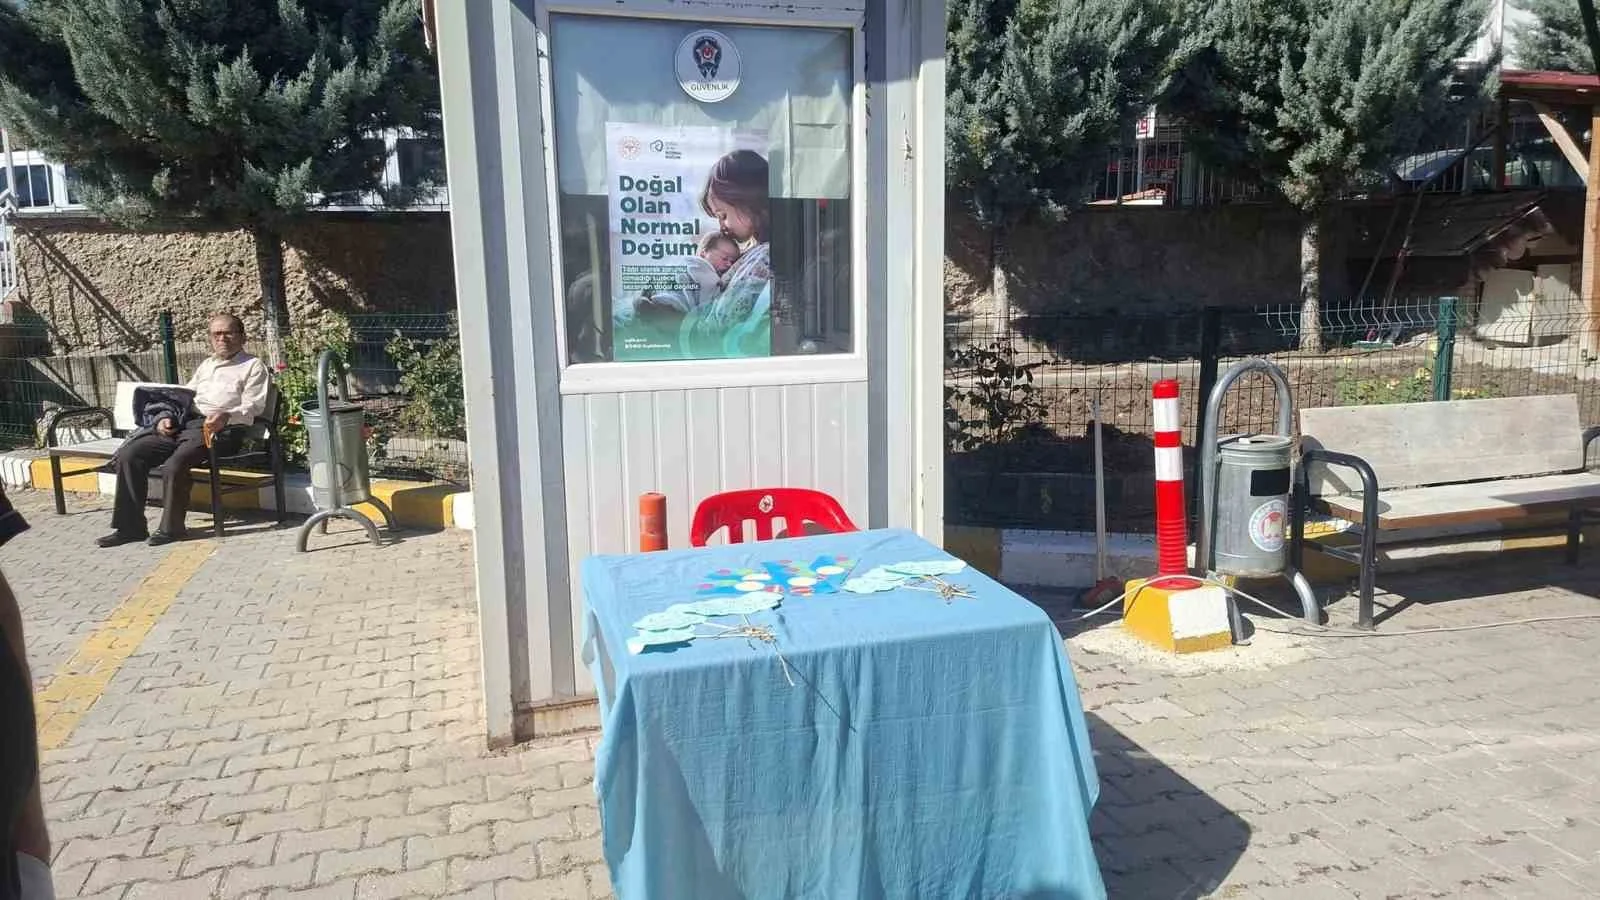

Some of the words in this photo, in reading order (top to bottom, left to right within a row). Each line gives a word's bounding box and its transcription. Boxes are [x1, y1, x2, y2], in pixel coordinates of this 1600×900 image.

[619, 175, 682, 196] Doğal
[620, 196, 671, 213] Olan
[621, 218, 700, 235] Normal
[622, 239, 698, 259] Doğum
